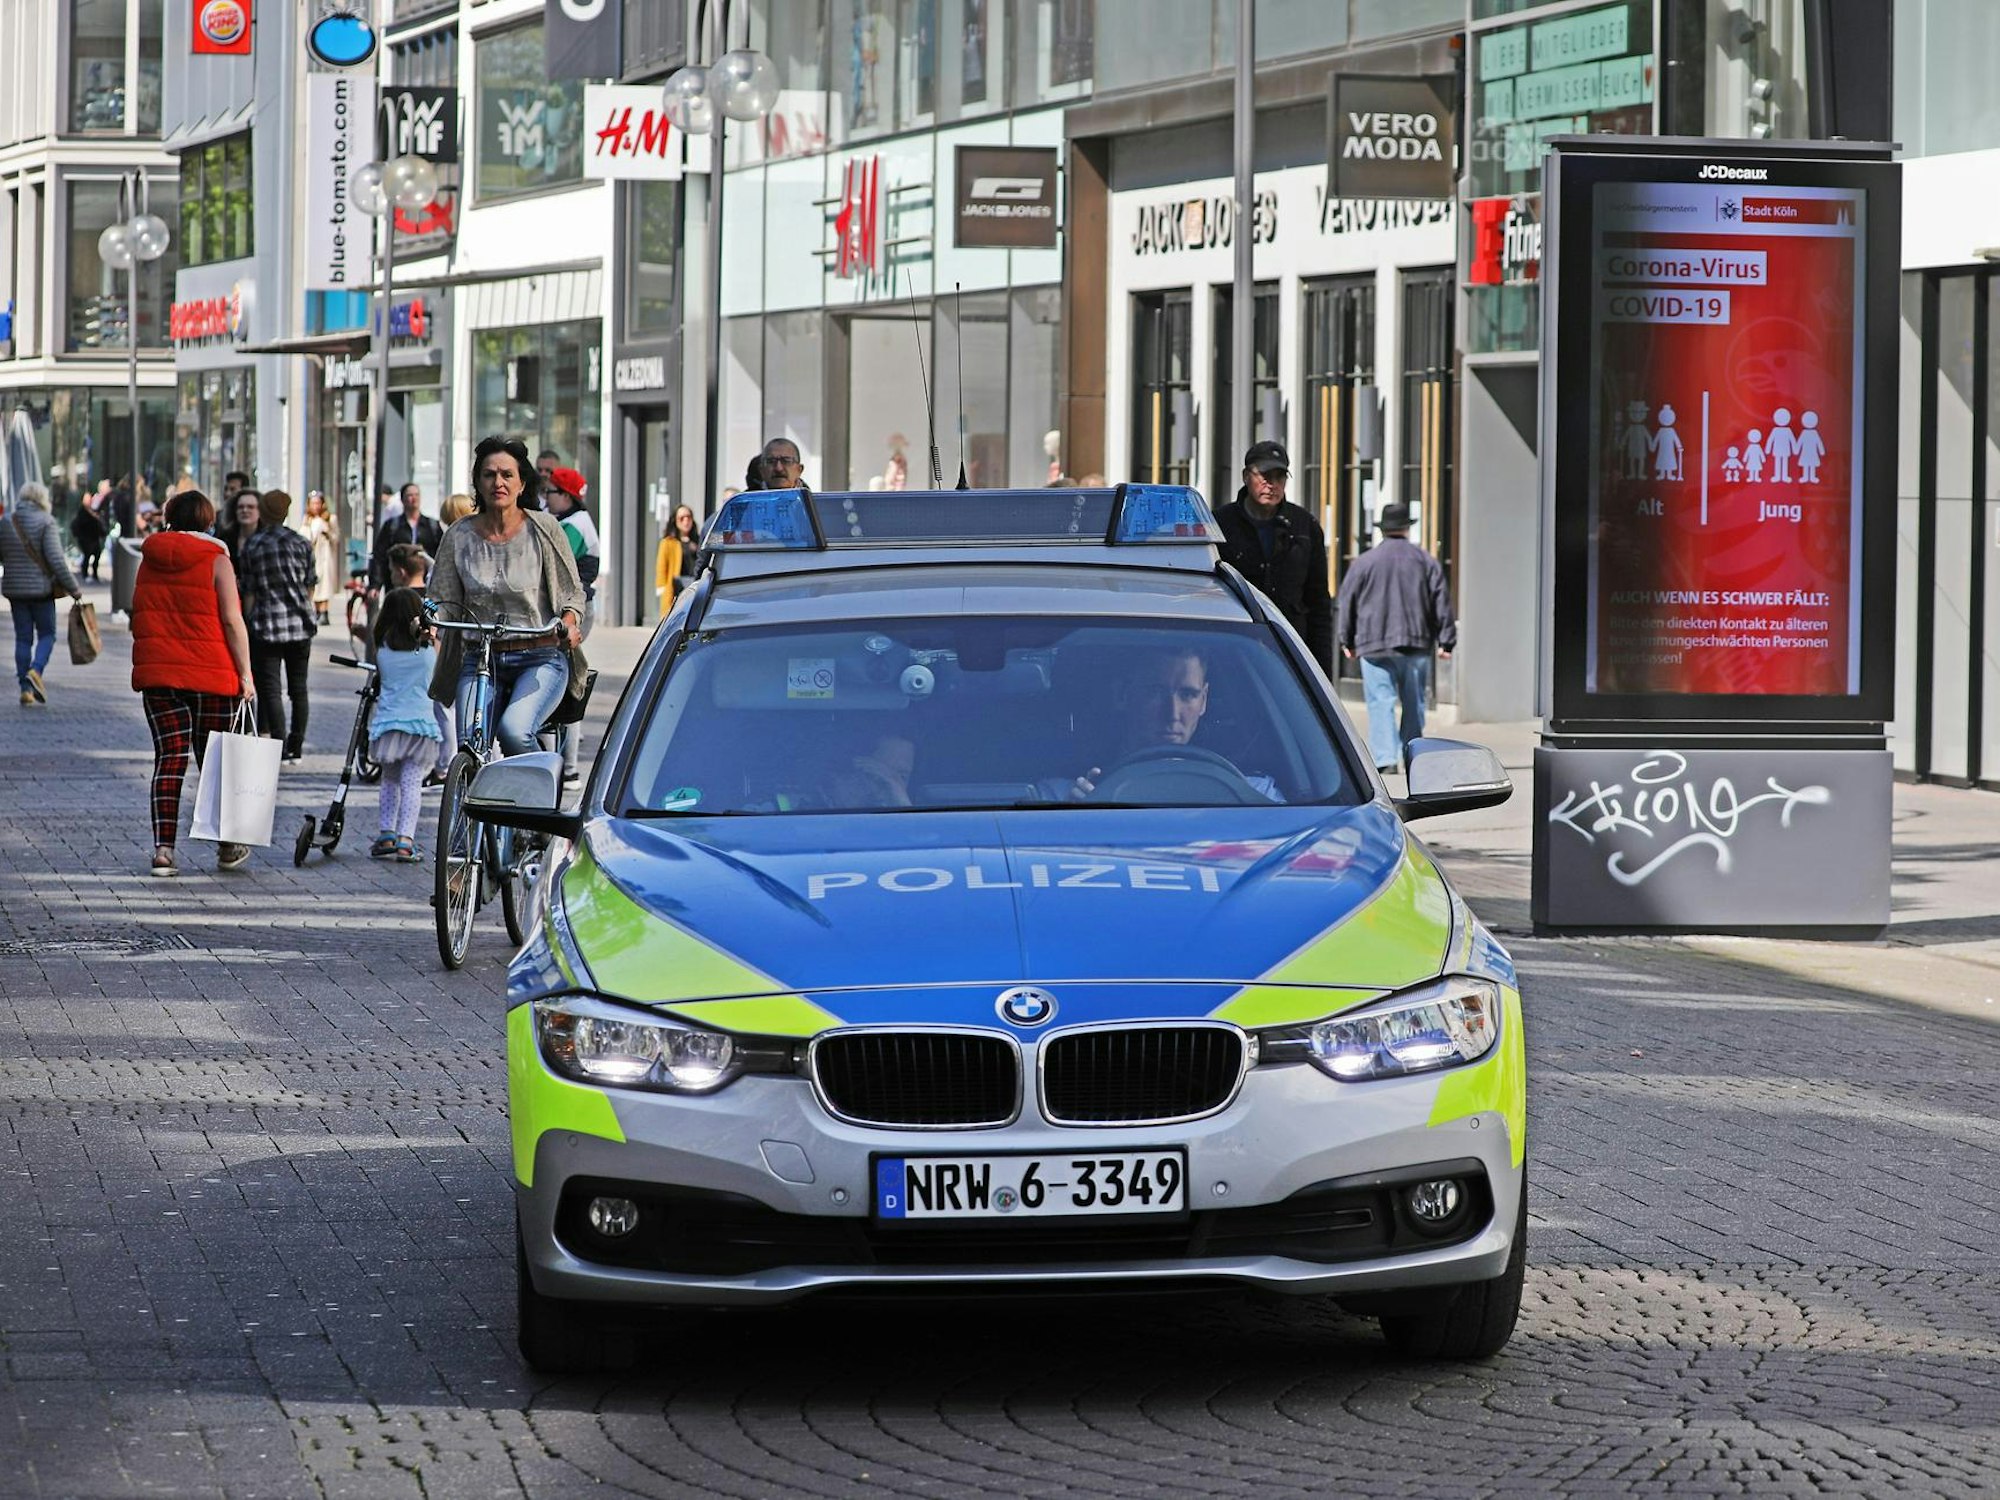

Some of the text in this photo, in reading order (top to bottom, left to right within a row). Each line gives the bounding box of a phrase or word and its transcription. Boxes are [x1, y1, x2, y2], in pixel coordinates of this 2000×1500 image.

[207, 15, 239, 31] KING
[596, 106, 671, 158] H&M
[1349, 112, 1438, 137] VERO
[1342, 136, 1443, 161] MODA
[329, 78, 347, 283] blue-tomato.com
[1698, 164, 1768, 181] JCDecaux
[1744, 205, 1798, 218] Stadt Köln
[1607, 256, 1760, 278] Corona-Virus
[1609, 297, 1722, 318] COVID-19
[1637, 498, 1665, 516] Alt
[1758, 500, 1802, 522] Jung
[1611, 589, 1830, 607] AUCH WENN ES SCHWER FÄLLT:
[1641, 615, 1665, 628] den
[1667, 616, 1717, 629] direkten
[1719, 617, 1767, 630] Kontakt
[1769, 620, 1784, 630] zu
[1786, 617, 1829, 631] älteren
[1772, 635, 1829, 649] Personen
[807, 864, 1220, 899] POLIZEI
[885, 1158, 1180, 1211] D NRW 6-3349
